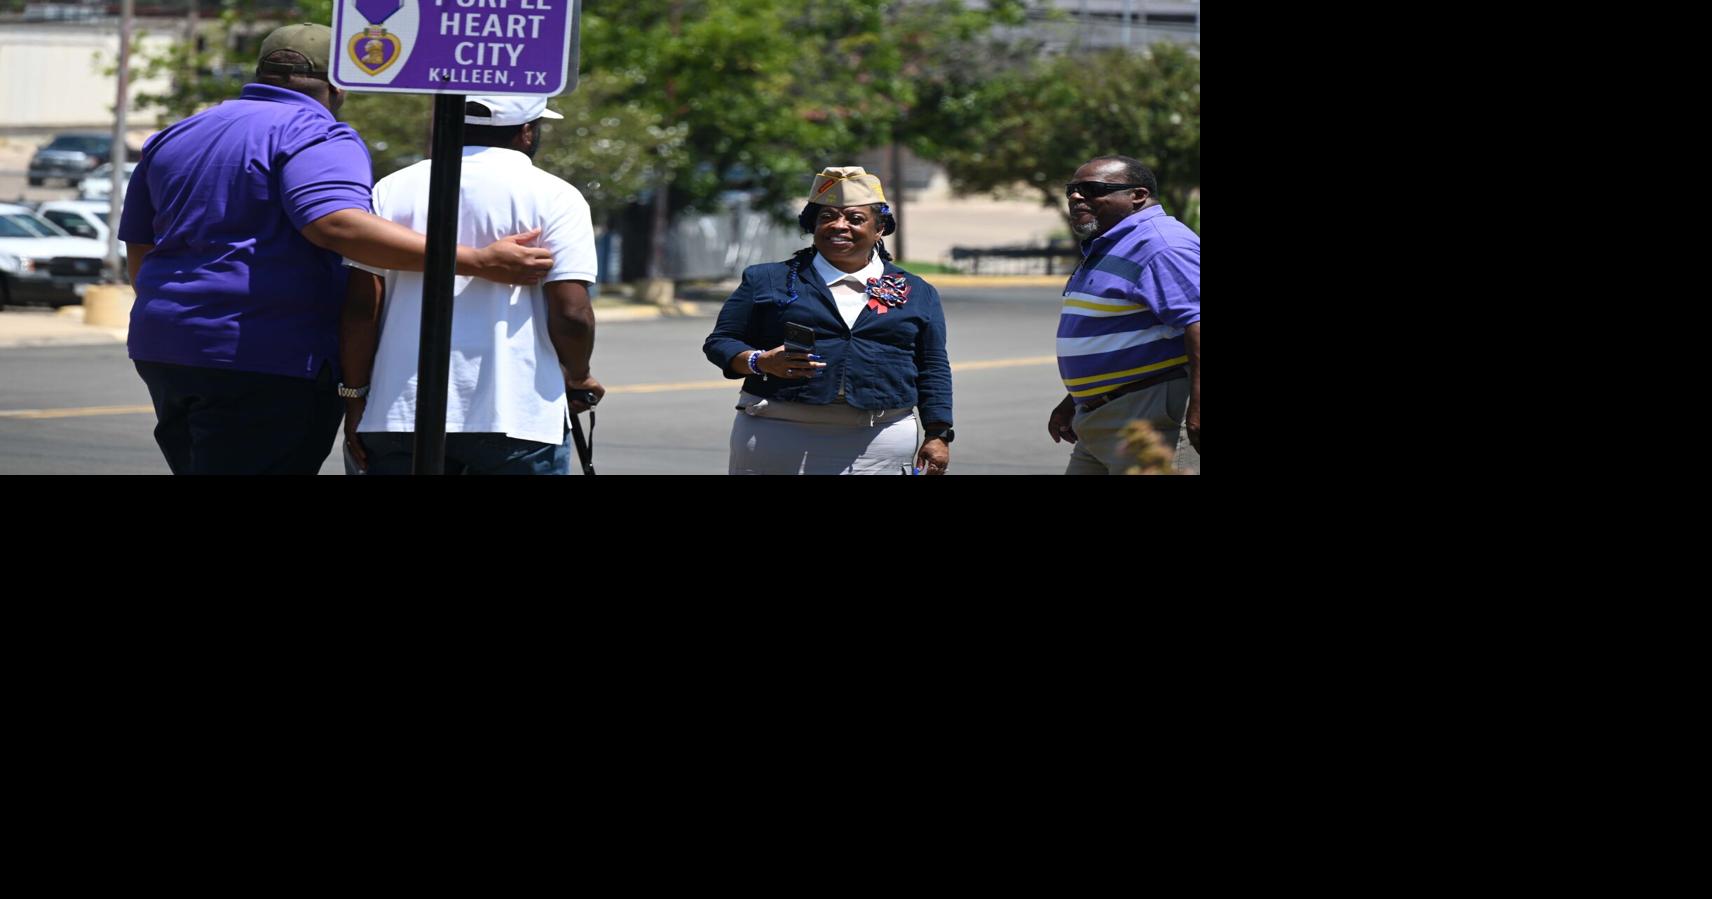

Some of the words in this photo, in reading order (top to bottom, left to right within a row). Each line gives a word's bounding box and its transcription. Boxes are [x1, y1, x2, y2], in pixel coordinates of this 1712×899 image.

[440, 12, 545, 38] HEART
[454, 41, 525, 66] CITY
[524, 71, 547, 85] TX
